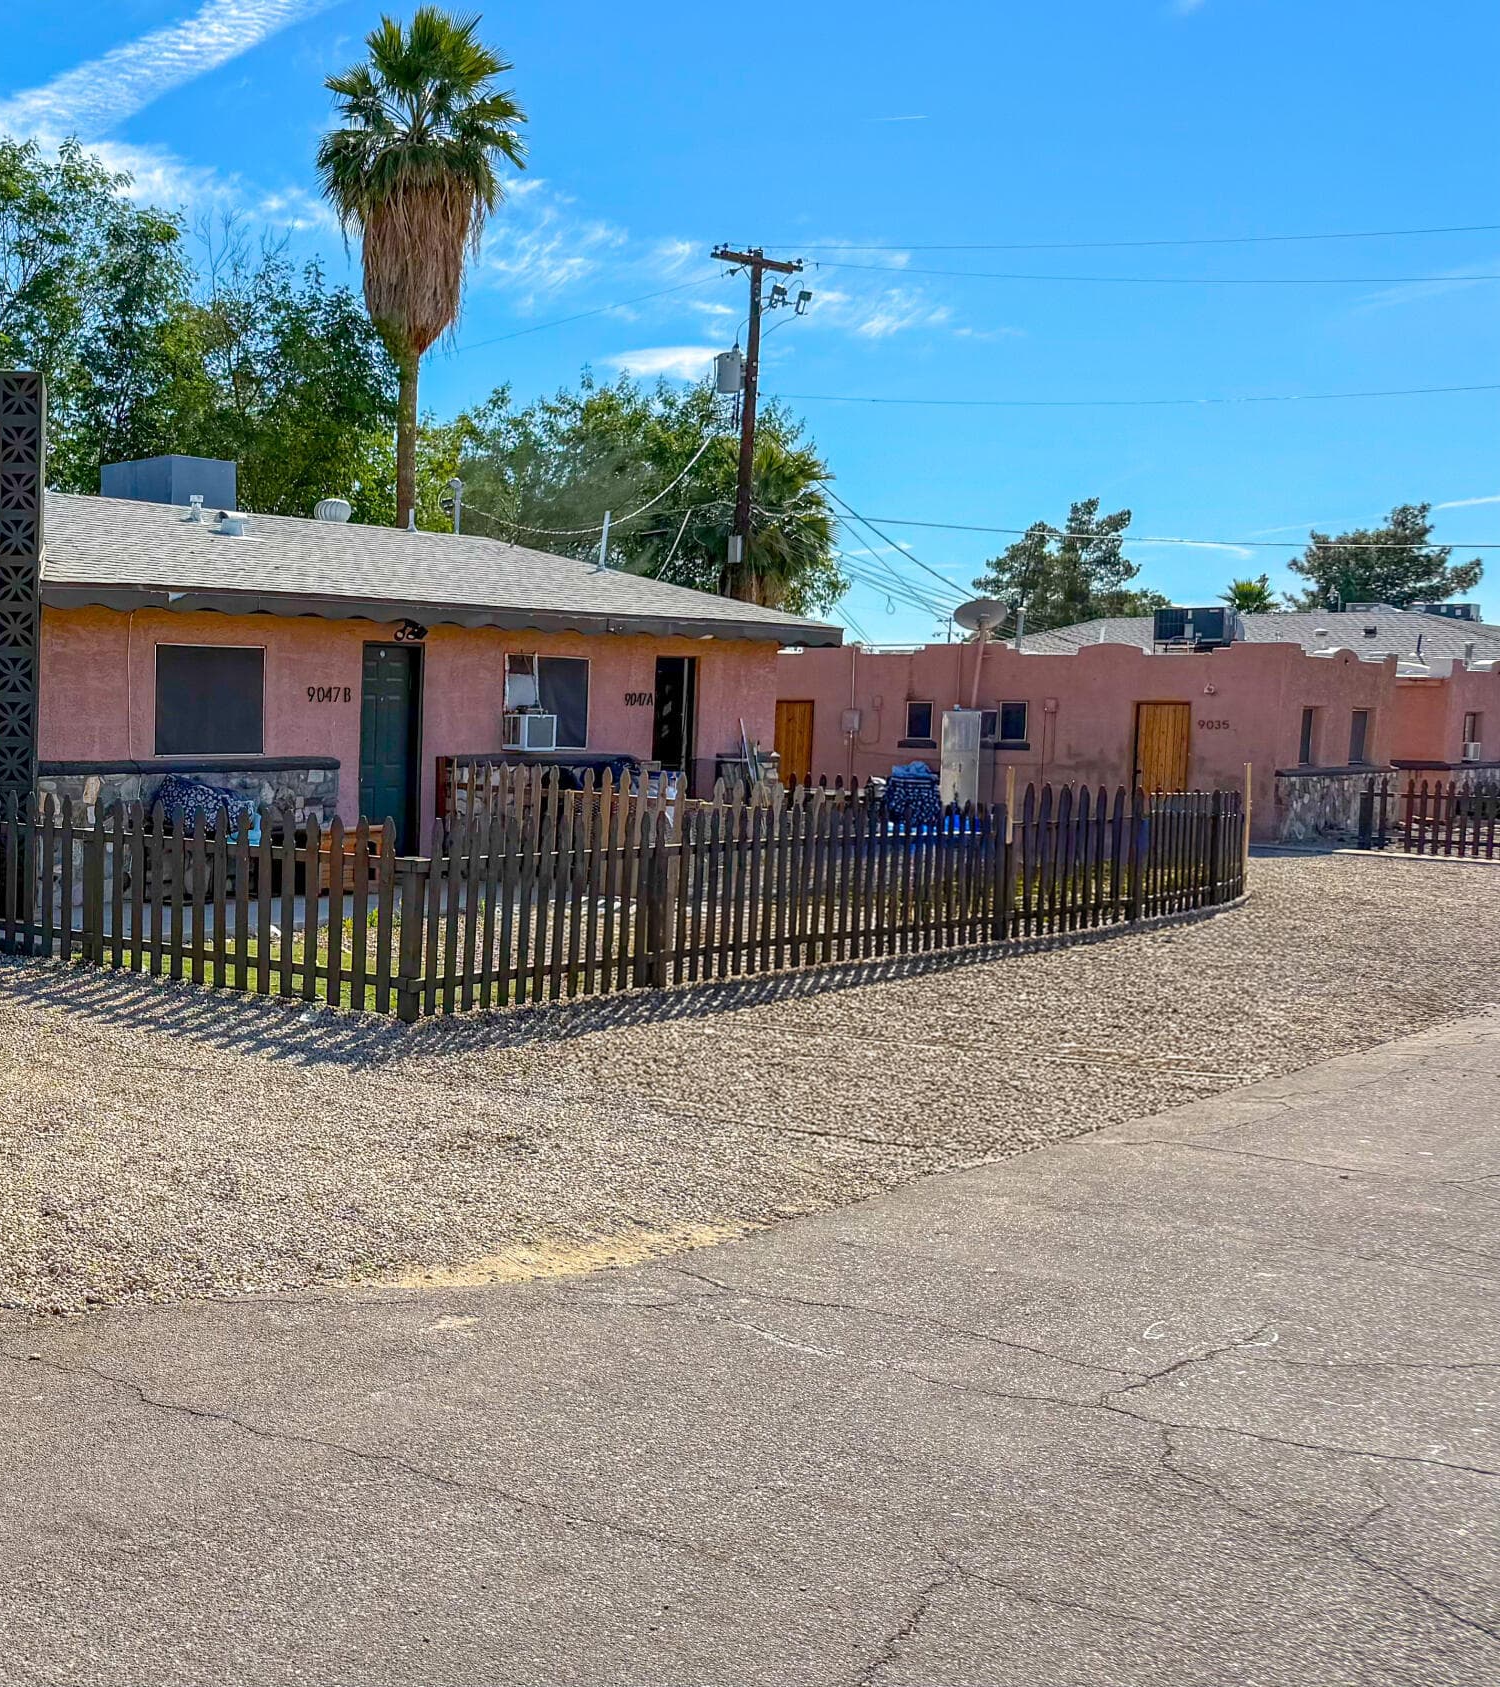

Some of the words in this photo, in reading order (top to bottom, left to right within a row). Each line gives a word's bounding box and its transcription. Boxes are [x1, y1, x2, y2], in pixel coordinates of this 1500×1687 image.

[307, 687, 341, 703] 9047
[343, 687, 351, 703] B
[1198, 720, 1229, 730] 9035
